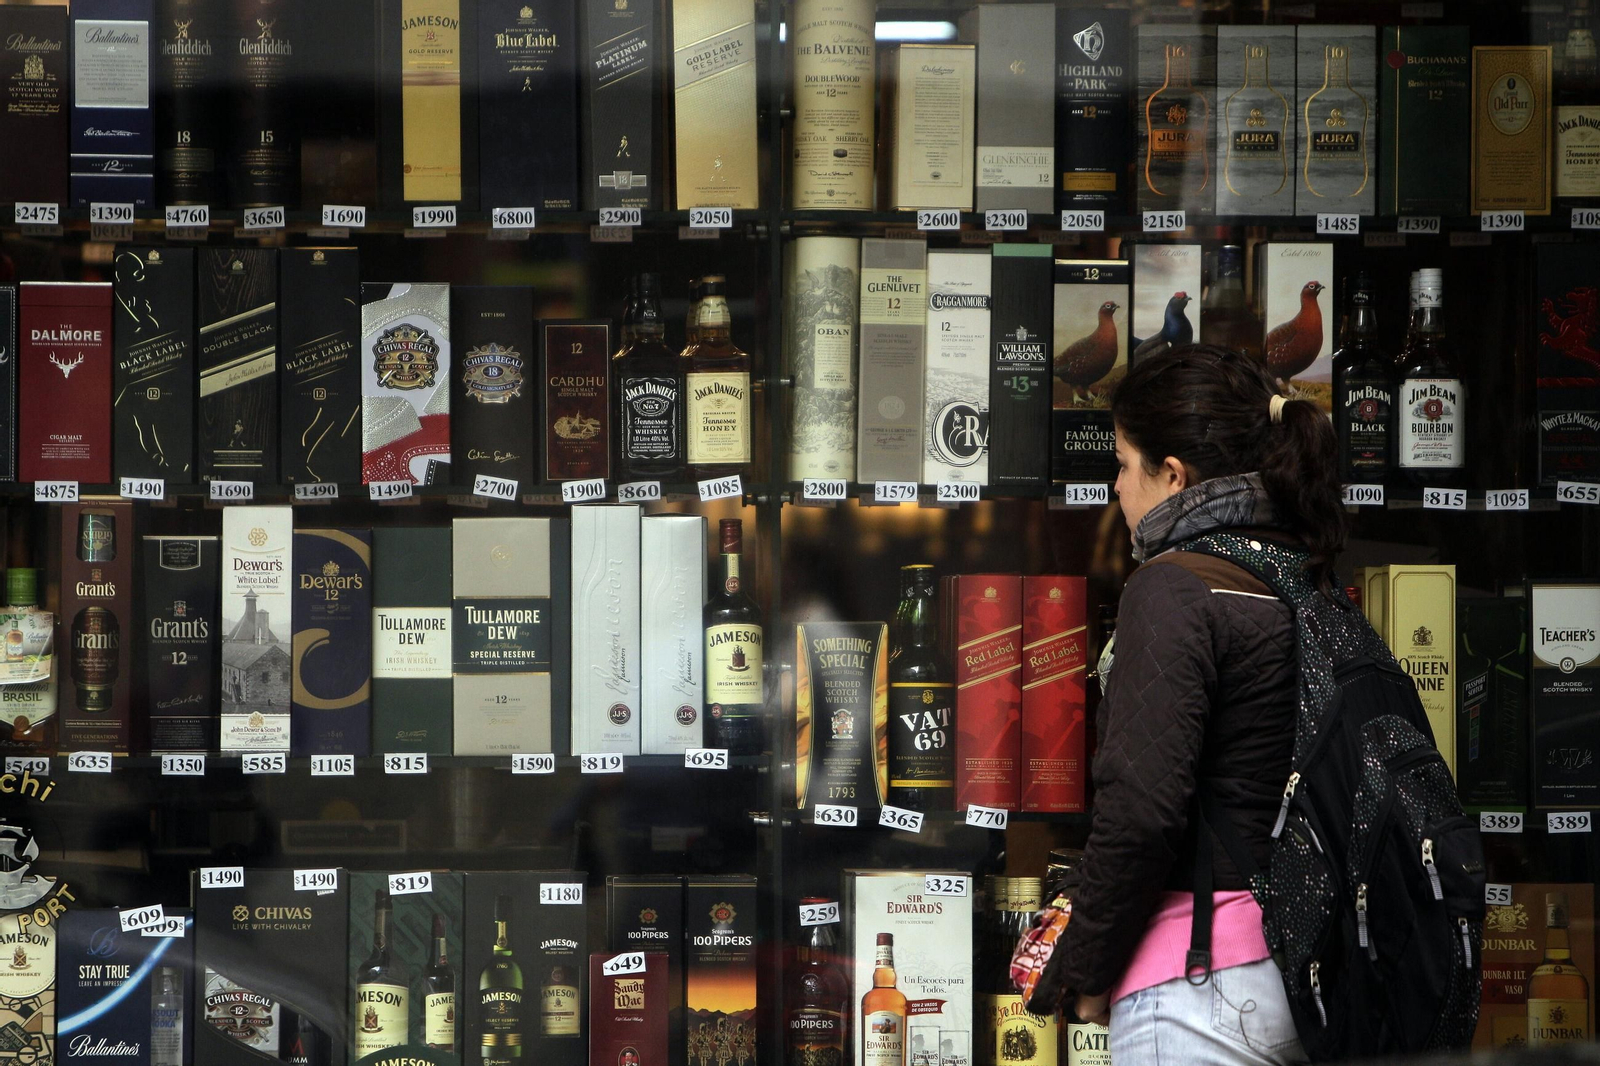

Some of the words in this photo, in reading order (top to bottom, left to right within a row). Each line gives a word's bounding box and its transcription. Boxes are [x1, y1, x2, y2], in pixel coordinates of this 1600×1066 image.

[402, 16, 458, 31] JAMESON
[5, 33, 62, 51] Ballantine's
[85, 27, 140, 44] Ballantine's
[495, 33, 524, 48] Blue
[239, 38, 292, 55] Glenfiddich
[685, 51, 712, 67] GOLD
[713, 38, 744, 57] LABEL
[814, 43, 871, 55] BALVENIE
[595, 40, 648, 69] PLATINUM
[691, 49, 742, 73] RESERVE
[1407, 55, 1467, 64] BUCHANAN'S
[1059, 64, 1123, 77] HIGHLAND
[1075, 78, 1107, 90] PARK
[177, 131, 191, 143] 18
[261, 131, 274, 143] 15
[1236, 133, 1275, 143] JURA
[1316, 133, 1355, 143] JURA
[982, 155, 1051, 165] GLENKINCHIE
[16, 205, 57, 222] $2475
[166, 208, 207, 223] $4760
[245, 208, 284, 226] $3650
[413, 208, 455, 224] $1990
[493, 210, 534, 225] $6800
[600, 209, 640, 224] $2900
[918, 213, 959, 228] $2600
[986, 213, 1026, 227] $2300
[1062, 213, 1103, 228] $2050
[1144, 214, 1183, 228] $2150
[1317, 217, 1358, 231] $1485
[1398, 218, 1438, 231] $1390
[886, 275, 902, 283] THE
[1083, 269, 1100, 280] 12
[867, 282, 921, 293] GLENLIVET
[930, 292, 988, 311] CRAGGANMORE
[31, 330, 102, 341] DALMORE
[817, 328, 850, 336] OBAN
[203, 336, 240, 354] DOUBLE
[377, 342, 407, 354] CHIVAS
[408, 342, 434, 354] REGAL
[571, 343, 583, 355] 12
[1002, 344, 1040, 352] WILLIAM
[119, 352, 153, 369] BLACK
[154, 341, 188, 359] LABEL
[285, 352, 320, 370] BLACK
[320, 341, 354, 359] LABEL
[466, 355, 494, 367] CHIVAS
[495, 355, 520, 368] REGAL
[550, 375, 605, 387] CARDHU
[1012, 375, 1029, 392] 13
[625, 385, 645, 400] JACK
[646, 382, 677, 401] DANIEL'S
[695, 385, 713, 400] JACK
[714, 382, 744, 400] DANIEL'S
[1345, 390, 1364, 406] JIM
[1365, 385, 1391, 406] BEAM
[1409, 388, 1428, 405] JIM
[1429, 384, 1456, 405] BEAM
[634, 417, 668, 425] Tennessee
[1351, 422, 1385, 431] BLACK
[1412, 423, 1453, 433] BOURBON
[1541, 414, 1566, 431] WHYTE
[1066, 431, 1116, 440] FAMOUS
[1064, 441, 1115, 451] GROUSE
[35, 485, 76, 498] $4875
[121, 480, 162, 496] $1490
[211, 484, 251, 497] $1690
[475, 478, 515, 496] $2700
[562, 482, 603, 498] $1900
[618, 485, 658, 499] $860
[700, 479, 740, 496] $1085
[804, 482, 844, 497] $2800
[876, 485, 916, 499] $1579
[1558, 486, 1598, 500] $655
[1067, 488, 1106, 501] $1390
[1425, 491, 1464, 506] $815
[1487, 493, 1527, 507] $1095
[233, 557, 284, 572] Dewar's
[300, 573, 363, 589] Dewar's
[76, 581, 116, 597] Grant's
[324, 590, 339, 601] 12
[463, 605, 541, 624] TULLAMORE
[151, 617, 208, 638] Grant's
[378, 613, 446, 632] TULLAMORE
[399, 632, 425, 645] DEW
[488, 626, 518, 640] DEW
[709, 630, 762, 648] JAMESON
[1540, 627, 1595, 645] TEACHER'S
[813, 638, 872, 654] SOMETHING
[172, 652, 187, 665] 12
[820, 654, 865, 669] SPECIAL
[965, 653, 986, 668] Red
[1030, 654, 1051, 668] Red
[1399, 658, 1449, 676] QUEEN
[824, 680, 861, 688] BLENDED
[3, 693, 42, 702] BRASIL
[827, 688, 858, 696] SCOTCH
[495, 695, 508, 704] 12
[825, 696, 860, 704] WHISKY
[900, 708, 951, 732] VAT
[914, 730, 946, 751] 69
[6, 761, 46, 773] $549
[70, 754, 110, 769] $635
[163, 758, 202, 772] $1350
[244, 757, 283, 770] $585
[312, 759, 352, 773] $1105
[513, 758, 552, 771] $1590
[582, 757, 620, 770] $819
[686, 752, 725, 768] $695
[829, 787, 855, 798] 1793
[815, 808, 855, 823] $630
[882, 810, 920, 829] $365
[968, 809, 1005, 826] $770
[1549, 815, 1588, 829] $389
[202, 870, 242, 885] $1490
[926, 879, 964, 893] $325
[541, 888, 580, 901] $1180
[907, 895, 922, 903] SIR
[17, 883, 76, 934] PORT
[255, 907, 312, 919] CHIVAS
[800, 906, 837, 922] $259
[887, 902, 943, 914] EDWARD'S
[122, 909, 161, 926] $609
[642, 931, 669, 939] PIPERS
[694, 936, 712, 946] 100
[713, 935, 752, 946] PIPERS
[540, 939, 577, 949] JAMESON
[79, 965, 102, 979] STAY
[105, 965, 130, 979] TRUE
[615, 981, 644, 994] Sandy
[1505, 985, 1523, 994] VASO
[207, 993, 240, 1006] CHIVAS
[243, 993, 271, 1007] REGAL
[481, 992, 522, 1004] JAMESON
[616, 995, 641, 1008] Mac
[800, 1020, 833, 1029] PIPERS
[1533, 1027, 1583, 1039] DUNBAR
[67, 1034, 139, 1057] Ballantine's
[866, 1041, 902, 1050] EDWARD'S
